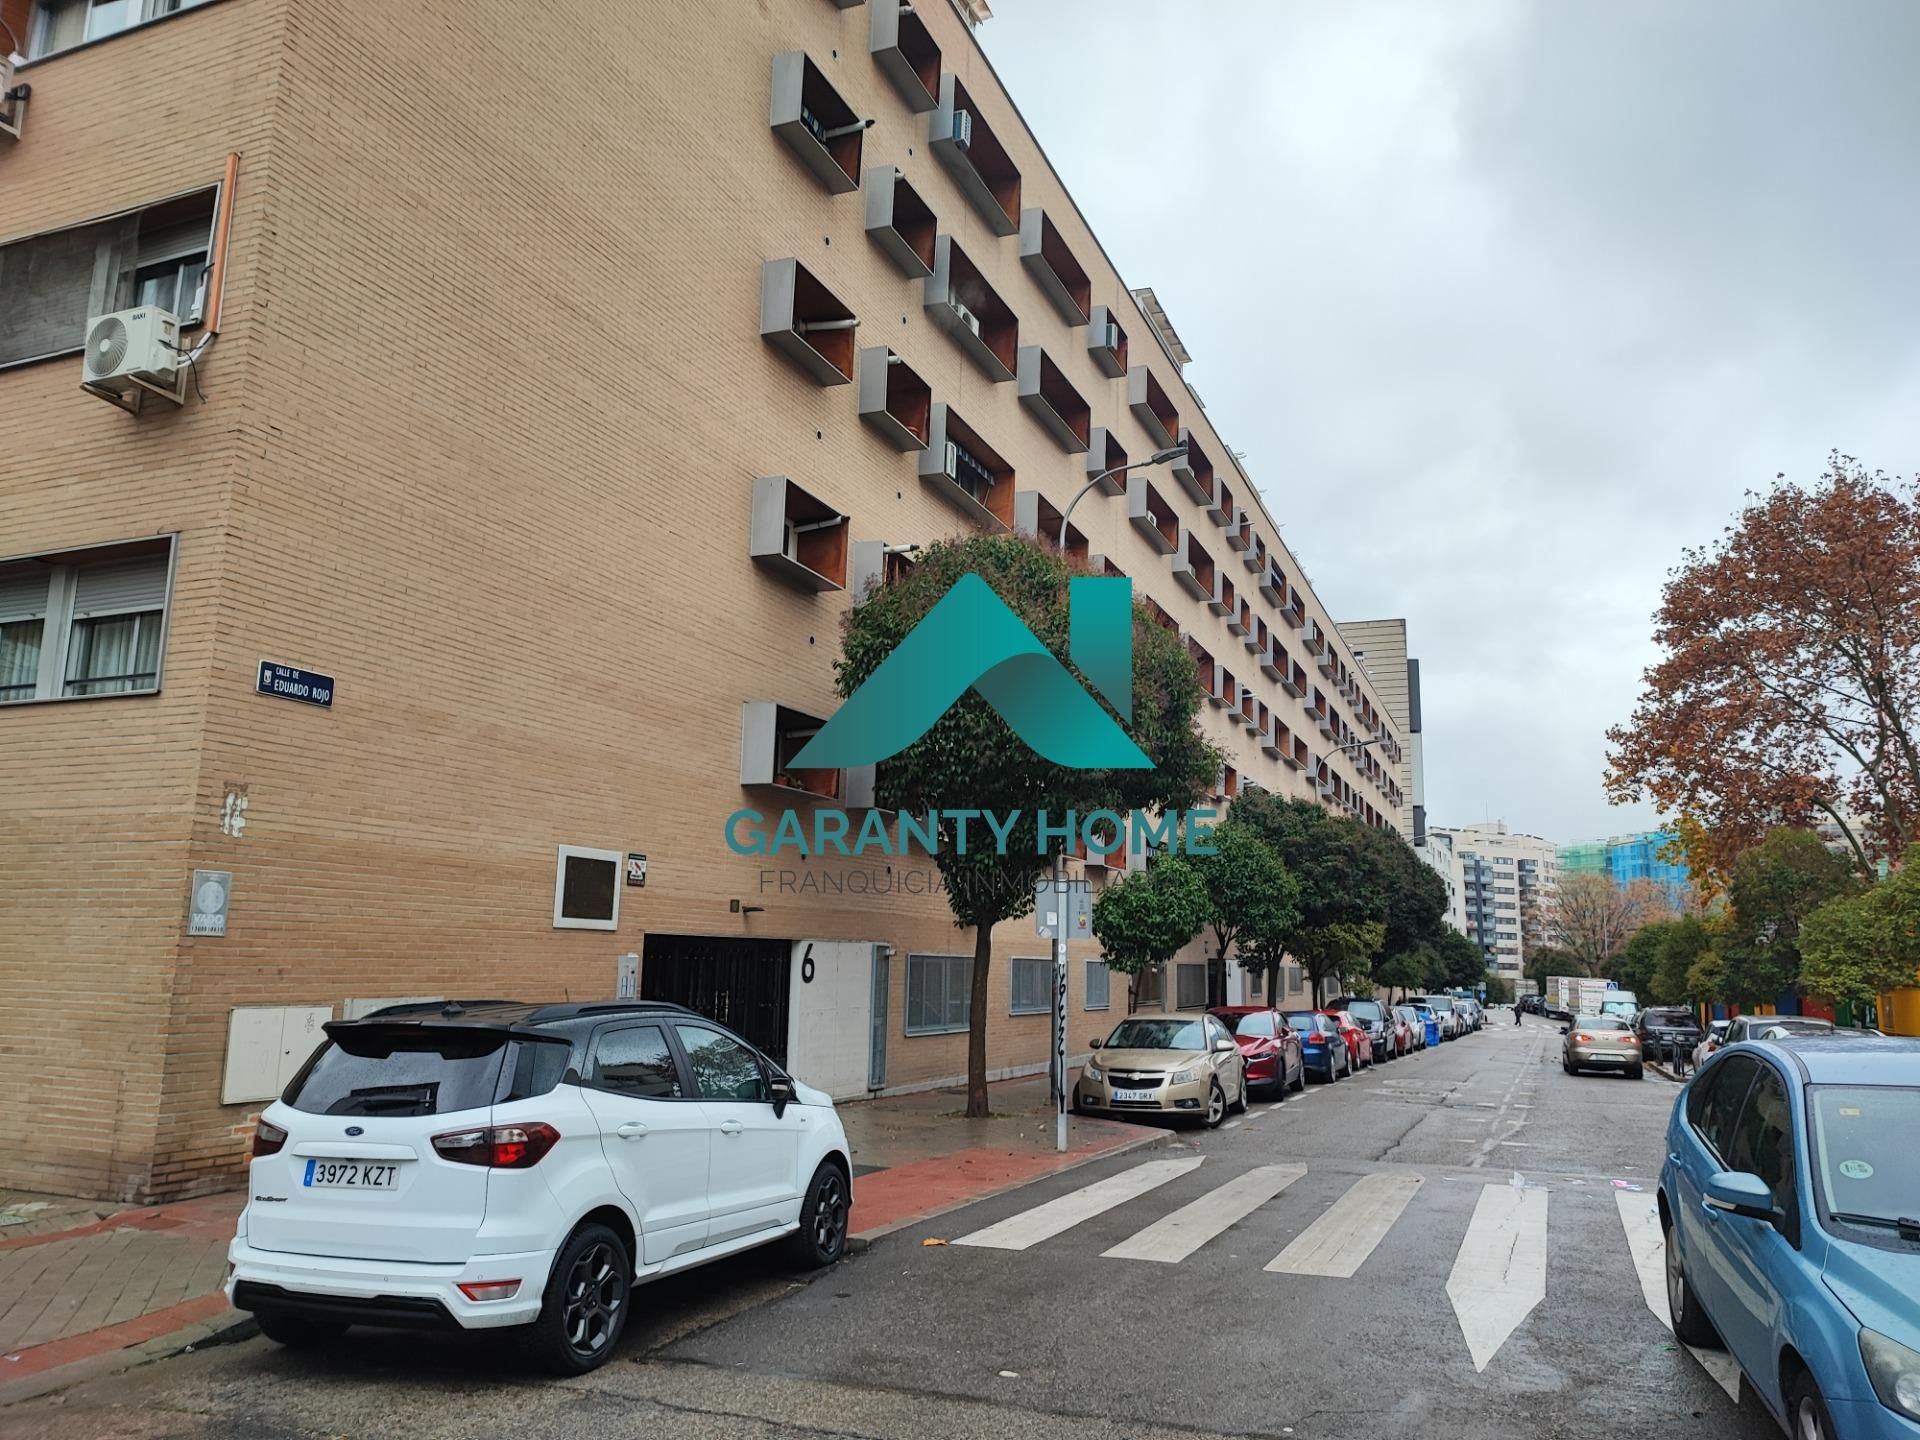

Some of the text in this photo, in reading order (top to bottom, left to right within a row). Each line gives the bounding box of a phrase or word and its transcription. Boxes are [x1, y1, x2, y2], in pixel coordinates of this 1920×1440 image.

[276, 667, 299, 679] CALLE DE
[274, 680, 330, 702] EDUARDO ROJO
[802, 943, 814, 984] 6
[316, 1164, 396, 1186] 3972 KZT
